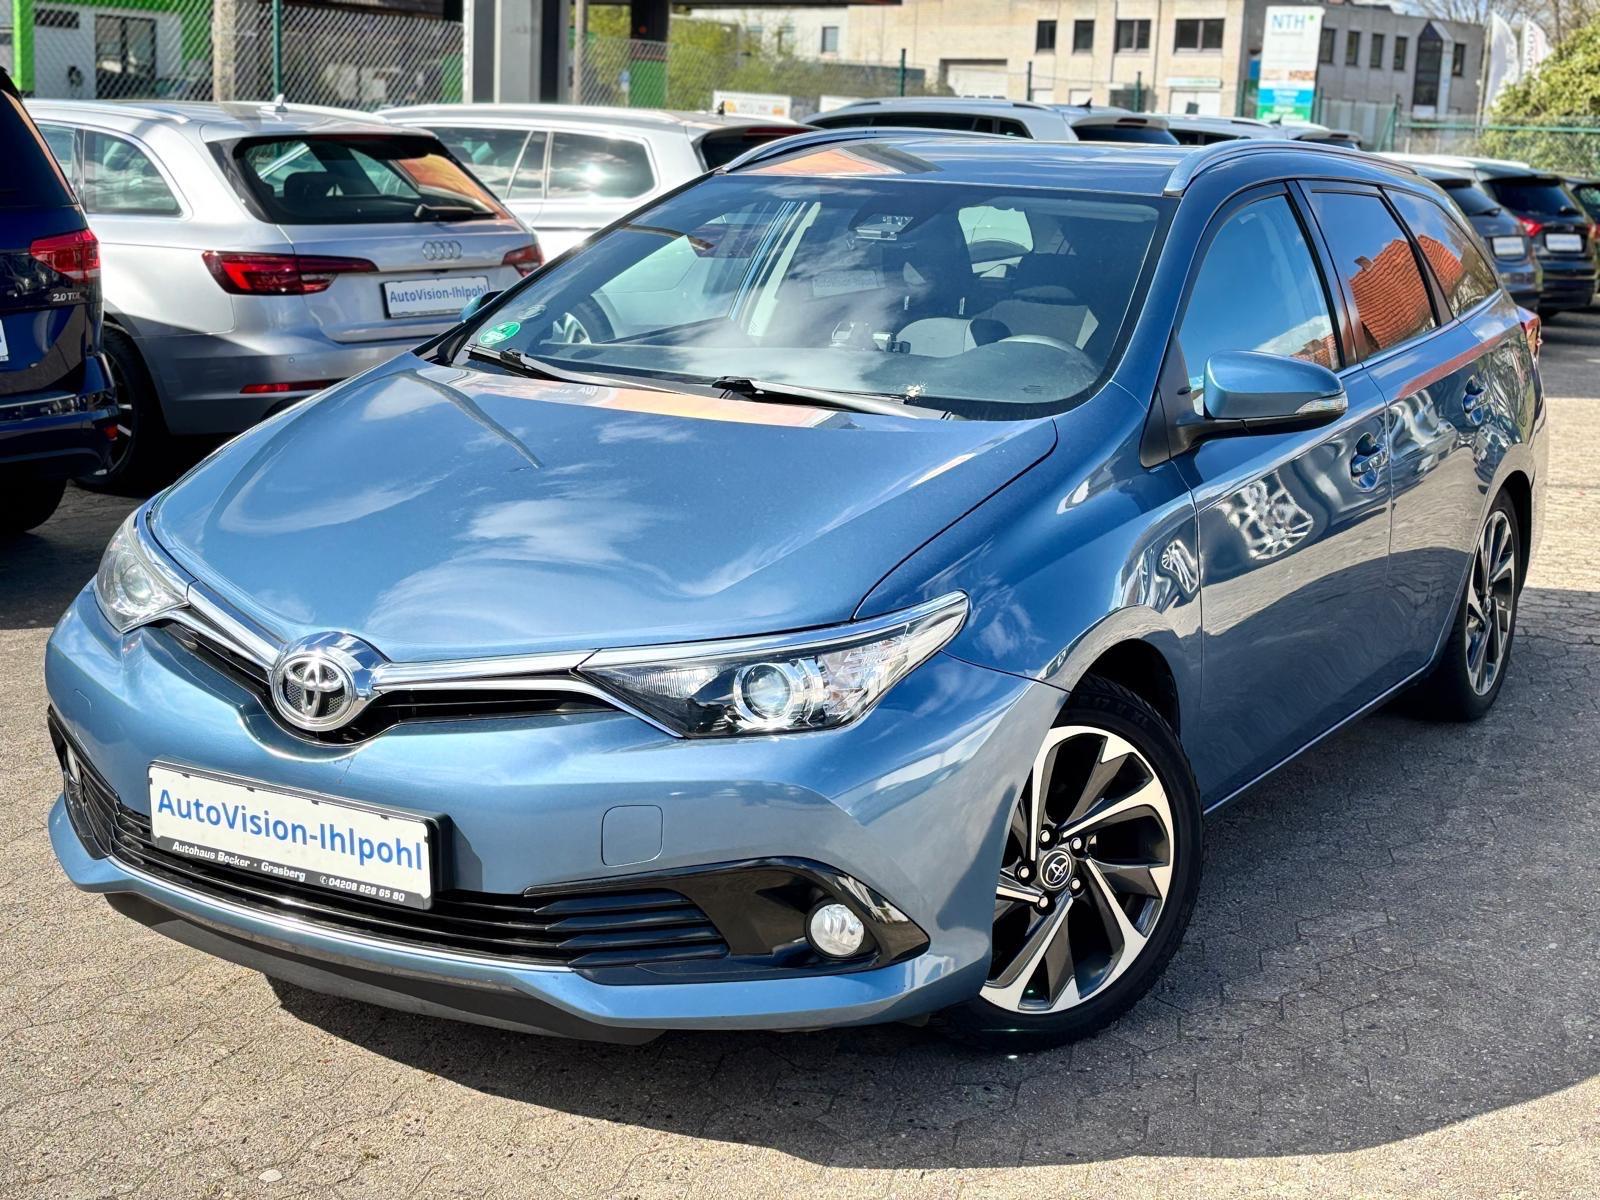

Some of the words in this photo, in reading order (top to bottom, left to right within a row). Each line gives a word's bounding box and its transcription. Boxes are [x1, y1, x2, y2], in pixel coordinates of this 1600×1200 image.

[1271, 14, 1305, 29] NTH
[157, 789, 423, 871] AutoVision-Ihlpohl
[172, 841, 216, 860] Autohaus
[217, 851, 251, 868] Becker
[261, 861, 306, 883] Grasberg
